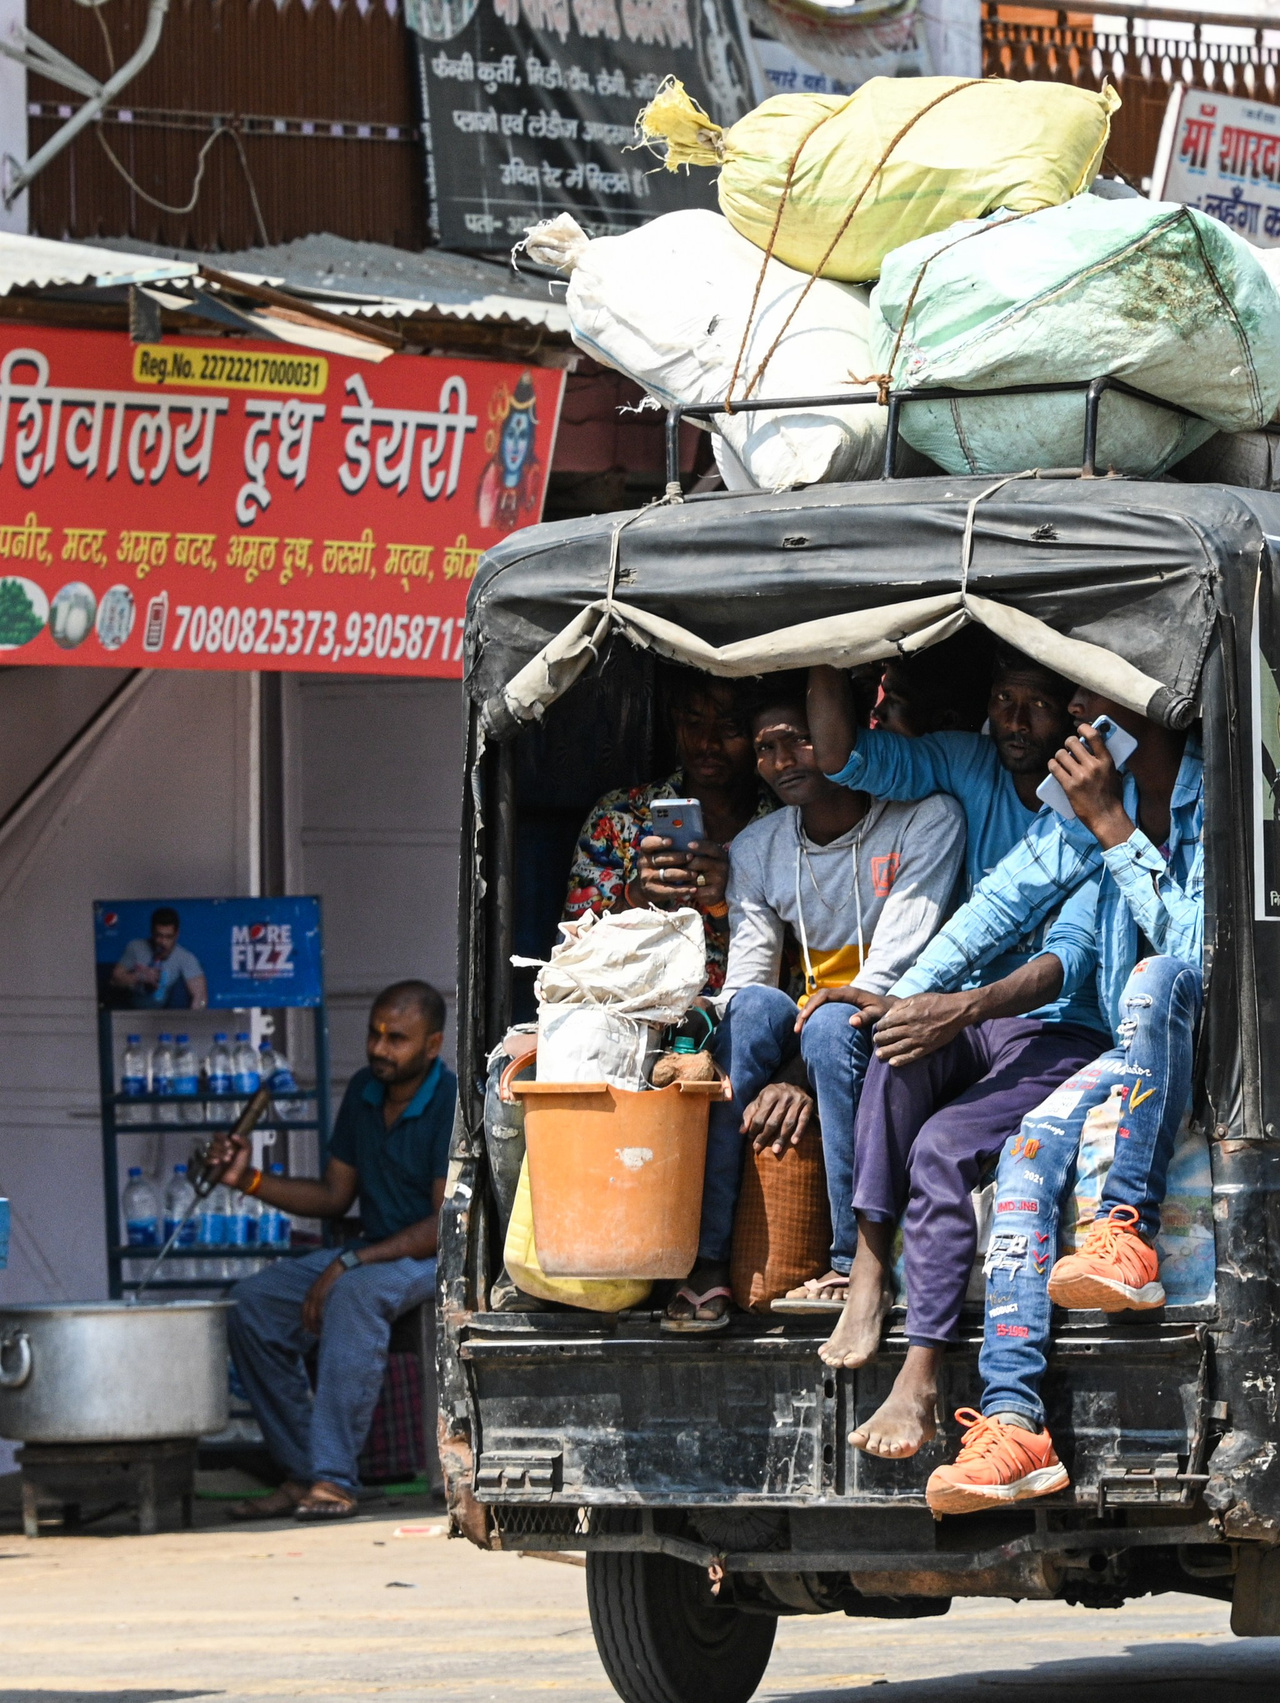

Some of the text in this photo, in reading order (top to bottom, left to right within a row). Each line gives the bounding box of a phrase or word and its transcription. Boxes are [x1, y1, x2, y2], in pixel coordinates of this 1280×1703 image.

[200, 354, 320, 388] 22722217000031
[0, 348, 478, 527] शिवालय दूध डेयरी
[62, 528, 108, 569] मटर,
[117, 530, 171, 581] अमूल
[174, 533, 217, 573] बटर,
[226, 535, 280, 584] अमूल
[282, 537, 314, 586] दूध,
[322, 528, 376, 581] लस्सी,
[232, 944, 294, 970] FIZZ
[1023, 1170, 1044, 1186] 2021
